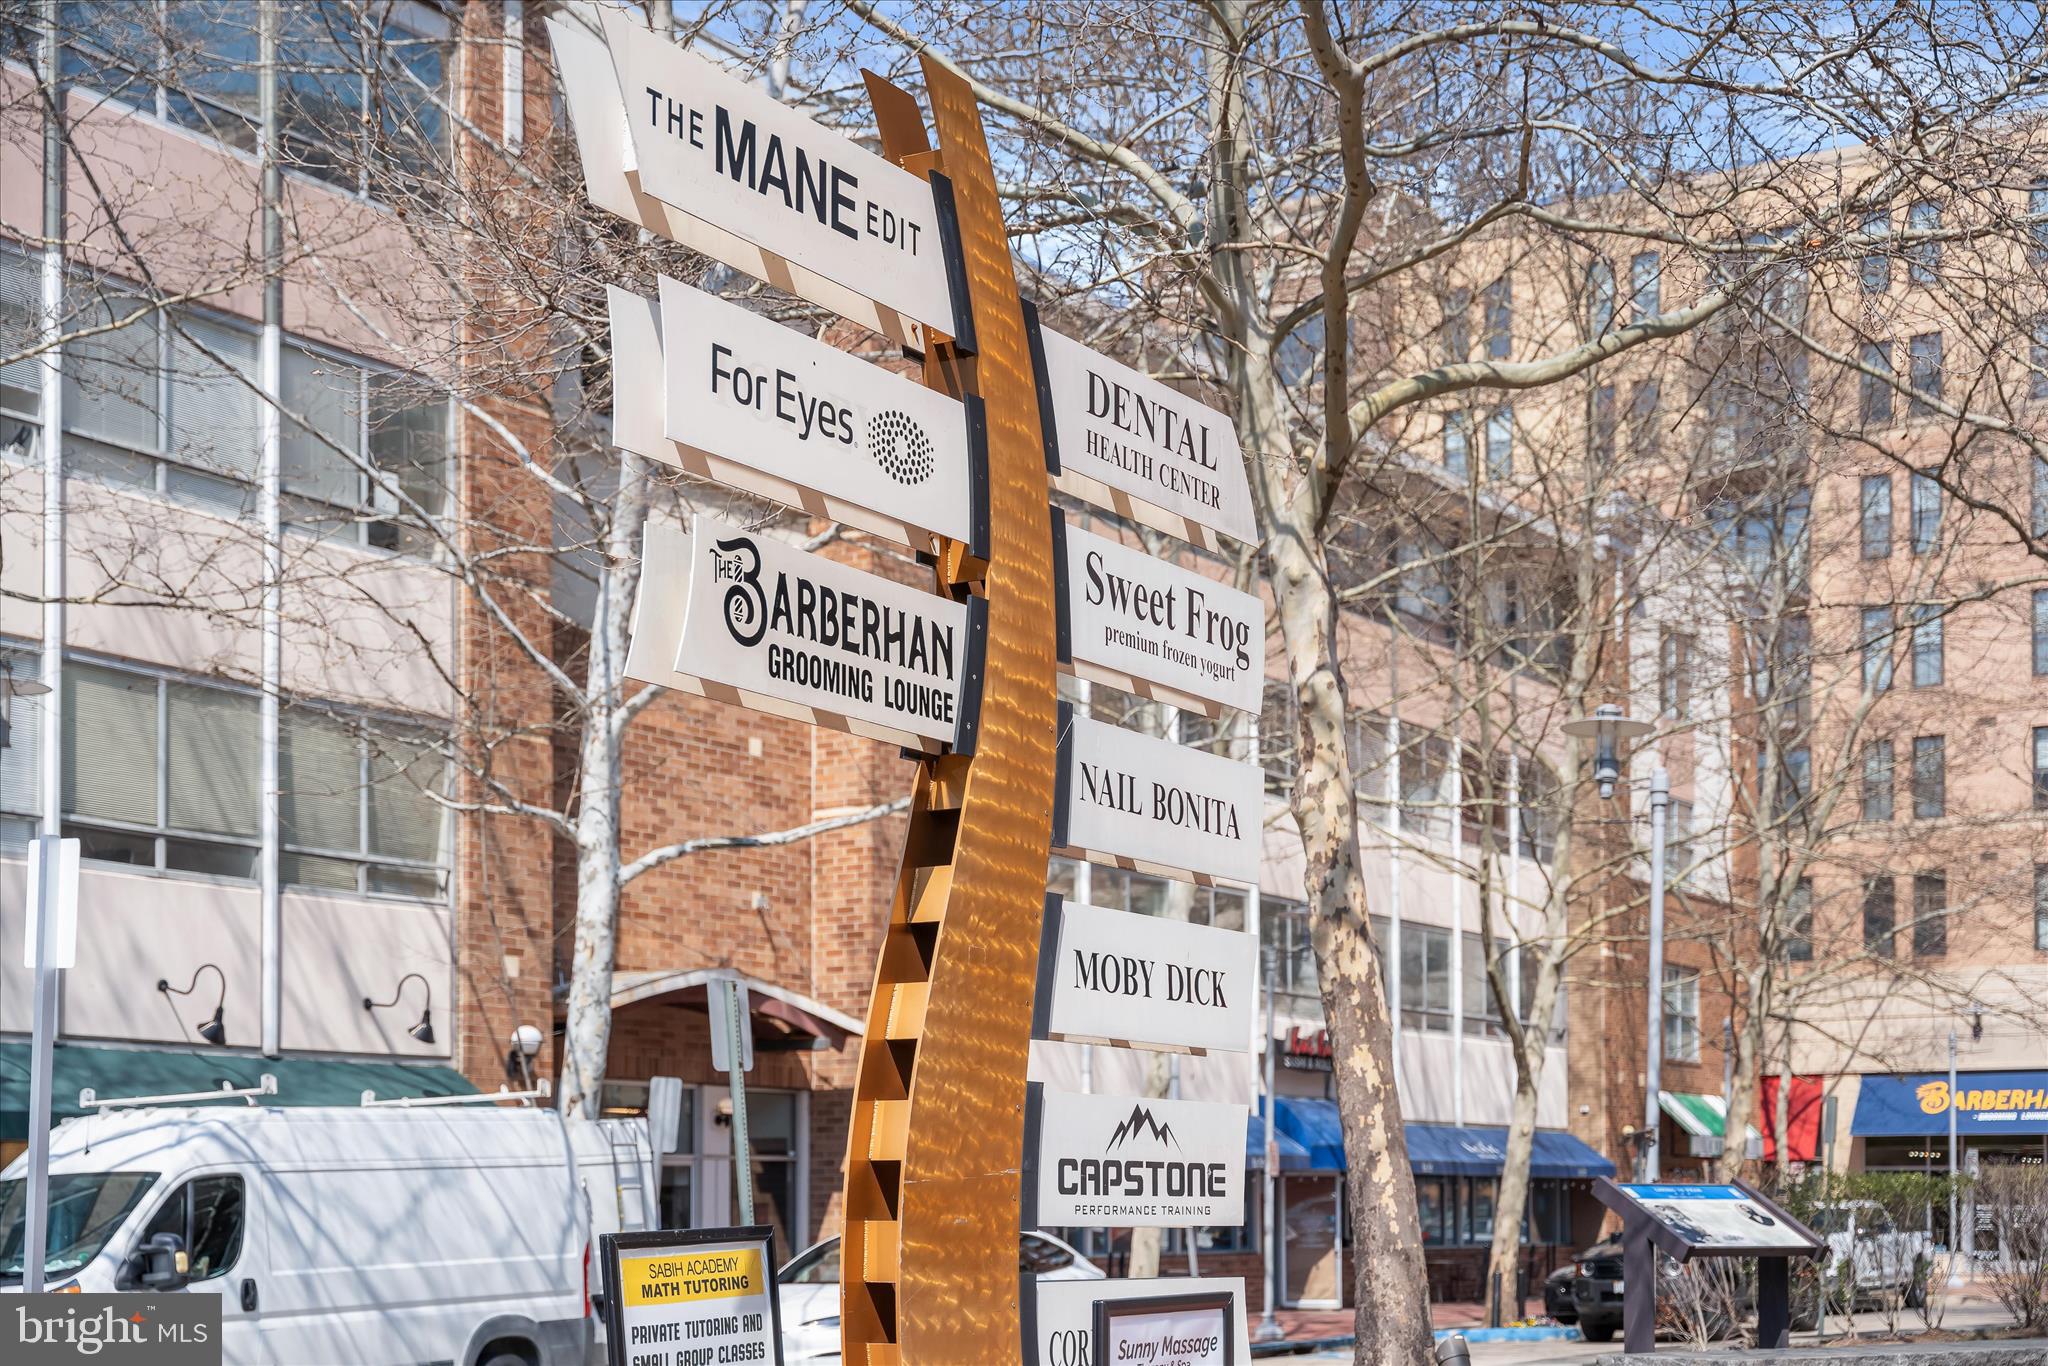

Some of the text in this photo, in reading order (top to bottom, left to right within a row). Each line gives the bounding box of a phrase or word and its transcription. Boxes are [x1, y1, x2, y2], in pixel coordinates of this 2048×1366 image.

[646, 87, 921, 256] THE MANE EDIT
[711, 342, 854, 446] For Eyes
[1086, 370, 1217, 471] DENTAL
[1086, 429, 1221, 510] HEALTH CENTER
[709, 537, 954, 681] THE BARBERHAN
[1085, 551, 1250, 670] Sweet Frog
[1105, 625, 1235, 682] premium frozen yogurt
[768, 644, 954, 724] GROOMING LOUNGE
[1079, 761, 1242, 840] NAIL BONITA
[1073, 949, 1228, 1009] MOBY DICK
[1058, 1158, 1226, 1197] CAPSTONE
[1075, 1205, 1211, 1216] PERFORMANCE TRAINING
[642, 1275, 749, 1299] MATH TUTORING
[649, 1257, 739, 1279] SABIH ACADEMY
[632, 1313, 763, 1345] PRIVATE TUTORING AND
[677, 1347, 713, 1366] GROUP
[718, 1341, 765, 1364] CLASSES
[1049, 1330, 1093, 1366] COR
[1118, 1335, 1218, 1363] Sunny Massage
